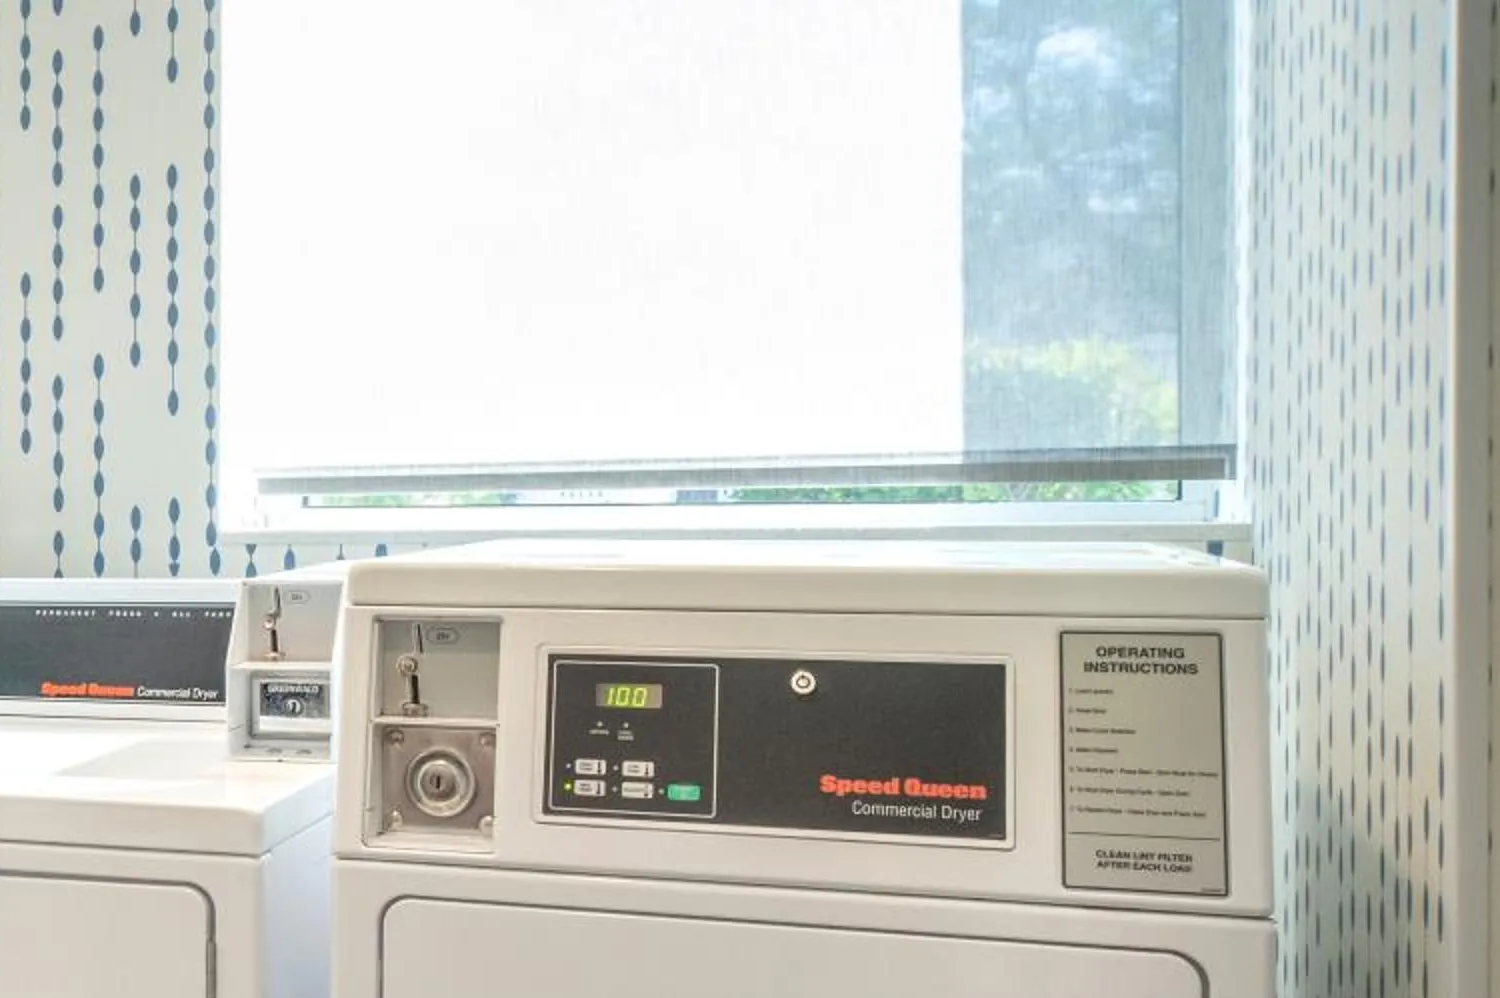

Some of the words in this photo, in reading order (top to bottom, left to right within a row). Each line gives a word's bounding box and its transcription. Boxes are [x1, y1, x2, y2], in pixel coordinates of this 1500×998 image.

[1095, 646, 1185, 659] OPERATING
[1083, 661, 1199, 675] INSTRUCTIONS
[41, 682, 87, 698] Speed
[137, 685, 191, 699] Commercial
[192, 687, 219, 701] Dryer
[606, 687, 649, 707] 100
[819, 774, 900, 797] Speed
[904, 777, 988, 800] Queen
[851, 799, 937, 818] Commercial
[941, 805, 984, 824] Dryer
[1095, 849, 1131, 859] CLEAN
[1157, 852, 1193, 863] FILTER
[1097, 860, 1130, 870] AFTER
[1133, 862, 1161, 871] EACH
